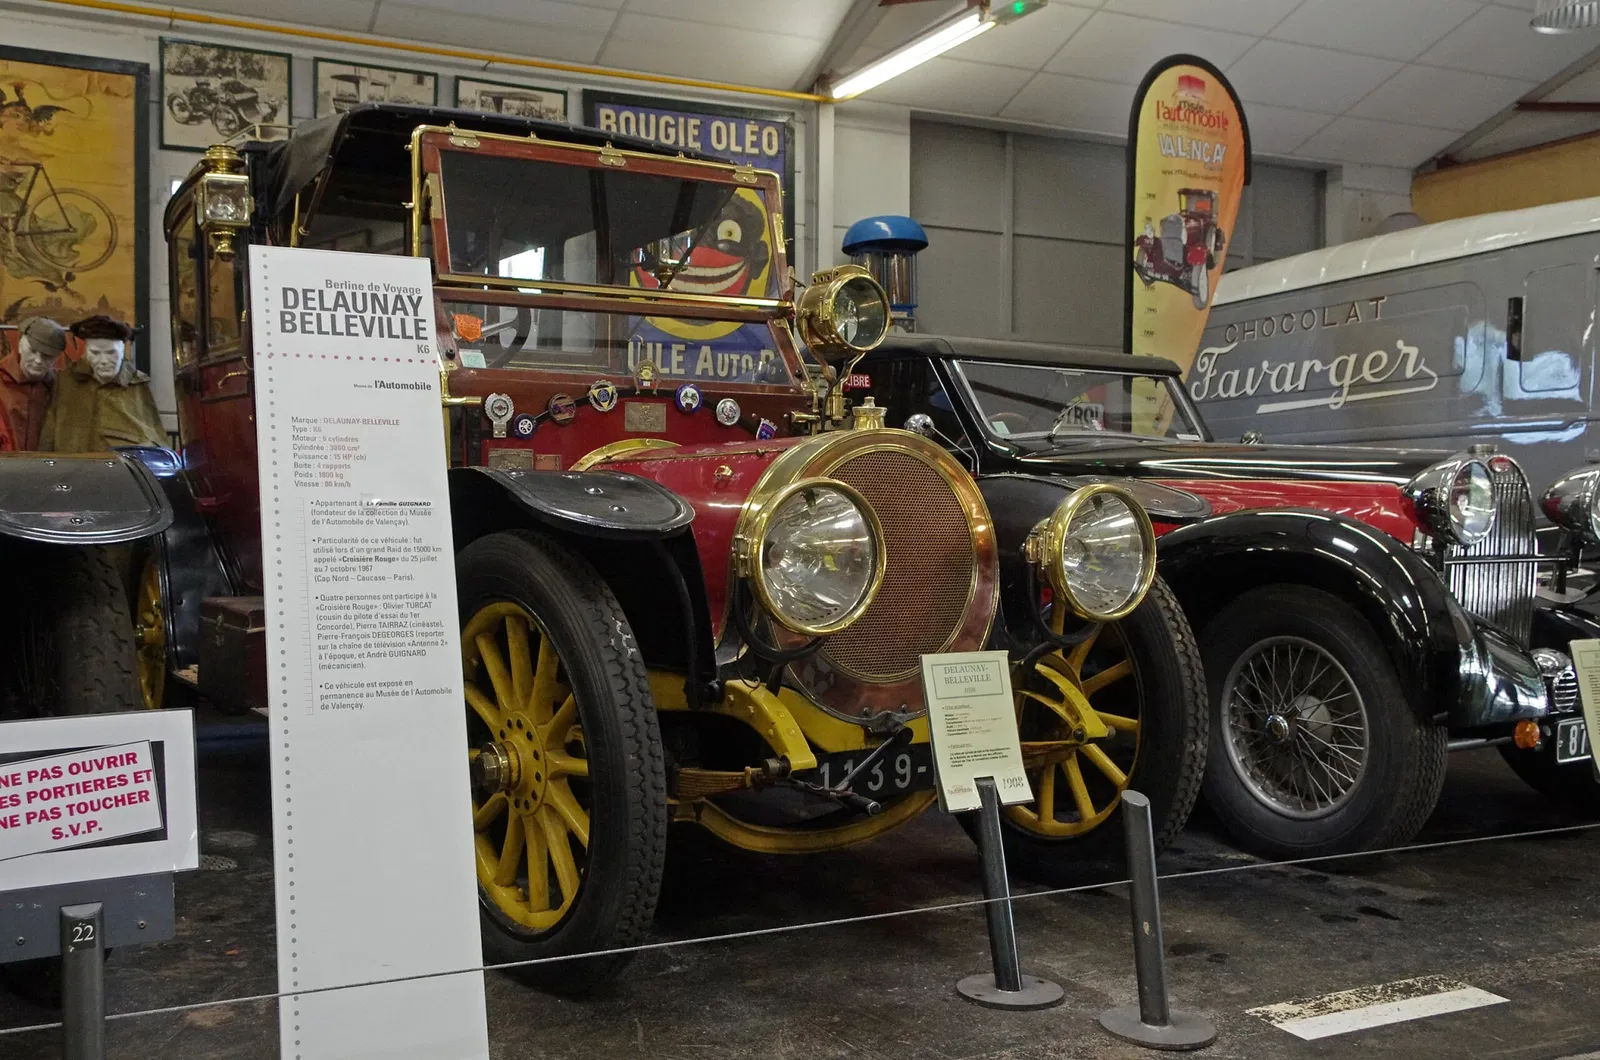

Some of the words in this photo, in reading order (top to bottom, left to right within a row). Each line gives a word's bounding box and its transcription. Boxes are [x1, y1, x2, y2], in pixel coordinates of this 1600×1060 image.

[600, 108, 701, 148] BOUGIE
[711, 120, 778, 156] OLÉO
[325, 279, 364, 291] Berline
[368, 282, 380, 292] de
[383, 283, 421, 296] Voyage
[282, 287, 423, 317] DELAUNAY
[280, 310, 428, 340] BELLEVILLE
[1224, 296, 1388, 345] CHOCOLAT
[417, 344, 430, 354] K6
[1191, 340, 1428, 409] Favarger
[375, 380, 431, 391] l'Automobile
[291, 416, 318, 424] Marque
[323, 417, 400, 425] DELAUNAY-BELLEVILLE
[292, 425, 308, 433] Type
[292, 434, 317, 442] Moteur
[293, 443, 325, 452] Cylindrée
[293, 452, 329, 460] Puissance
[342, 453, 352, 461] HP
[353, 453, 367, 461] (ch)
[322, 463, 351, 471] rapports
[294, 470, 313, 478] Poids
[335, 471, 344, 480] kg
[294, 480, 320, 488] Vitesse
[325, 480, 333, 488] 80
[334, 480, 352, 488] km/h
[315, 500, 358, 508] Appartenant
[311, 509, 347, 517] (fondateur
[311, 518, 321, 526] de
[322, 518, 364, 526] l'Automobile
[365, 518, 374, 526] de
[380, 536, 408, 544] véhicule
[314, 556, 336, 564] appelé
[419, 555, 437, 563] juillet
[315, 575, 330, 583] (Cap
[345, 594, 380, 602] personnes
[395, 593, 424, 601] participé
[405, 601, 432, 609] TURCAT
[316, 613, 342, 621] (cousin
[354, 613, 373, 621] pilote
[317, 632, 370, 641] Pierre-François
[372, 630, 414, 639] DEGEORGES
[415, 630, 444, 638] (reporter
[325, 652, 356, 661] l'époque,
[366, 650, 387, 658] André
[389, 649, 426, 658] GUIGNARD
[944, 664, 988, 674] DELAUNAY-
[944, 674, 991, 685] BELLEVILLE
[325, 682, 334, 690] Ce
[379, 680, 403, 688] exposé
[320, 692, 364, 701] permanence
[376, 690, 399, 698] Musée
[411, 687, 452, 696] l'Automobile
[331, 702, 364, 710] Valençay.
[0, 773, 22, 789] NE
[27, 766, 63, 784] PAS
[68, 752, 138, 776] OUVRIR
[1002, 776, 1024, 790] 1908
[0, 794, 21, 810] ES
[26, 774, 128, 804] PORTIERES
[133, 769, 152, 784] ET
[0, 814, 21, 830] NE
[26, 806, 62, 825] PAS
[66, 789, 150, 816] TOUCHER
[51, 819, 102, 840] S.V.P.
[72, 925, 95, 943] 22
